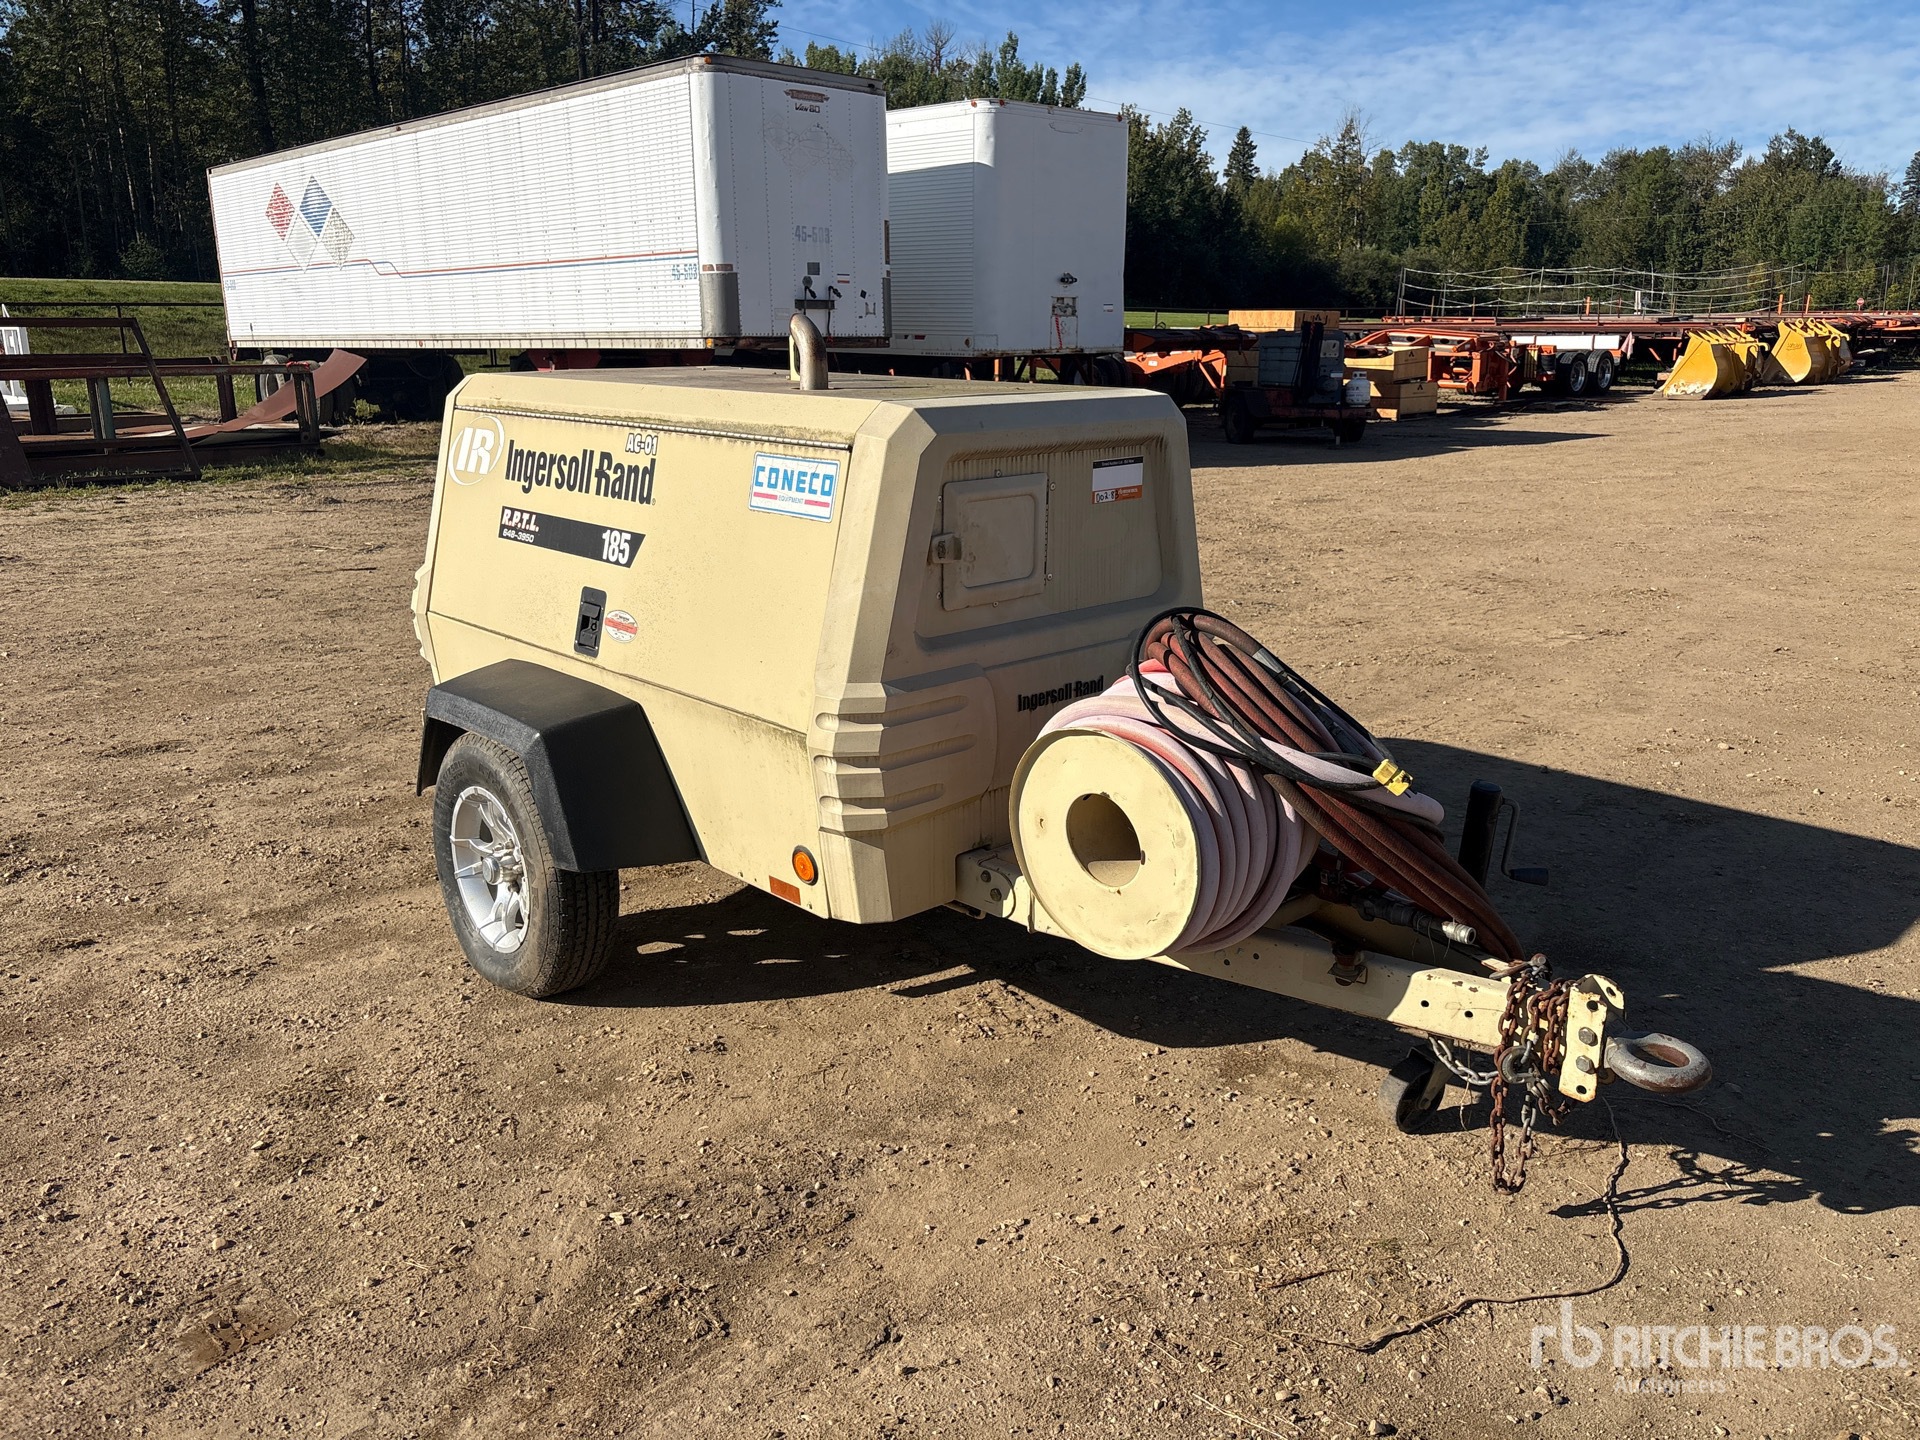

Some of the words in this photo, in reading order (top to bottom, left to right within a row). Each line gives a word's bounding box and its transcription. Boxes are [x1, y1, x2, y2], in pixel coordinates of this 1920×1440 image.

[794, 225, 830, 244] 45-503
[625, 433, 658, 456] AC-01
[754, 465, 834, 497] CONECO
[778, 495, 804, 504] EQUIPMENT
[501, 508, 540, 532] R.P.T.L.
[602, 529, 632, 565] 185
